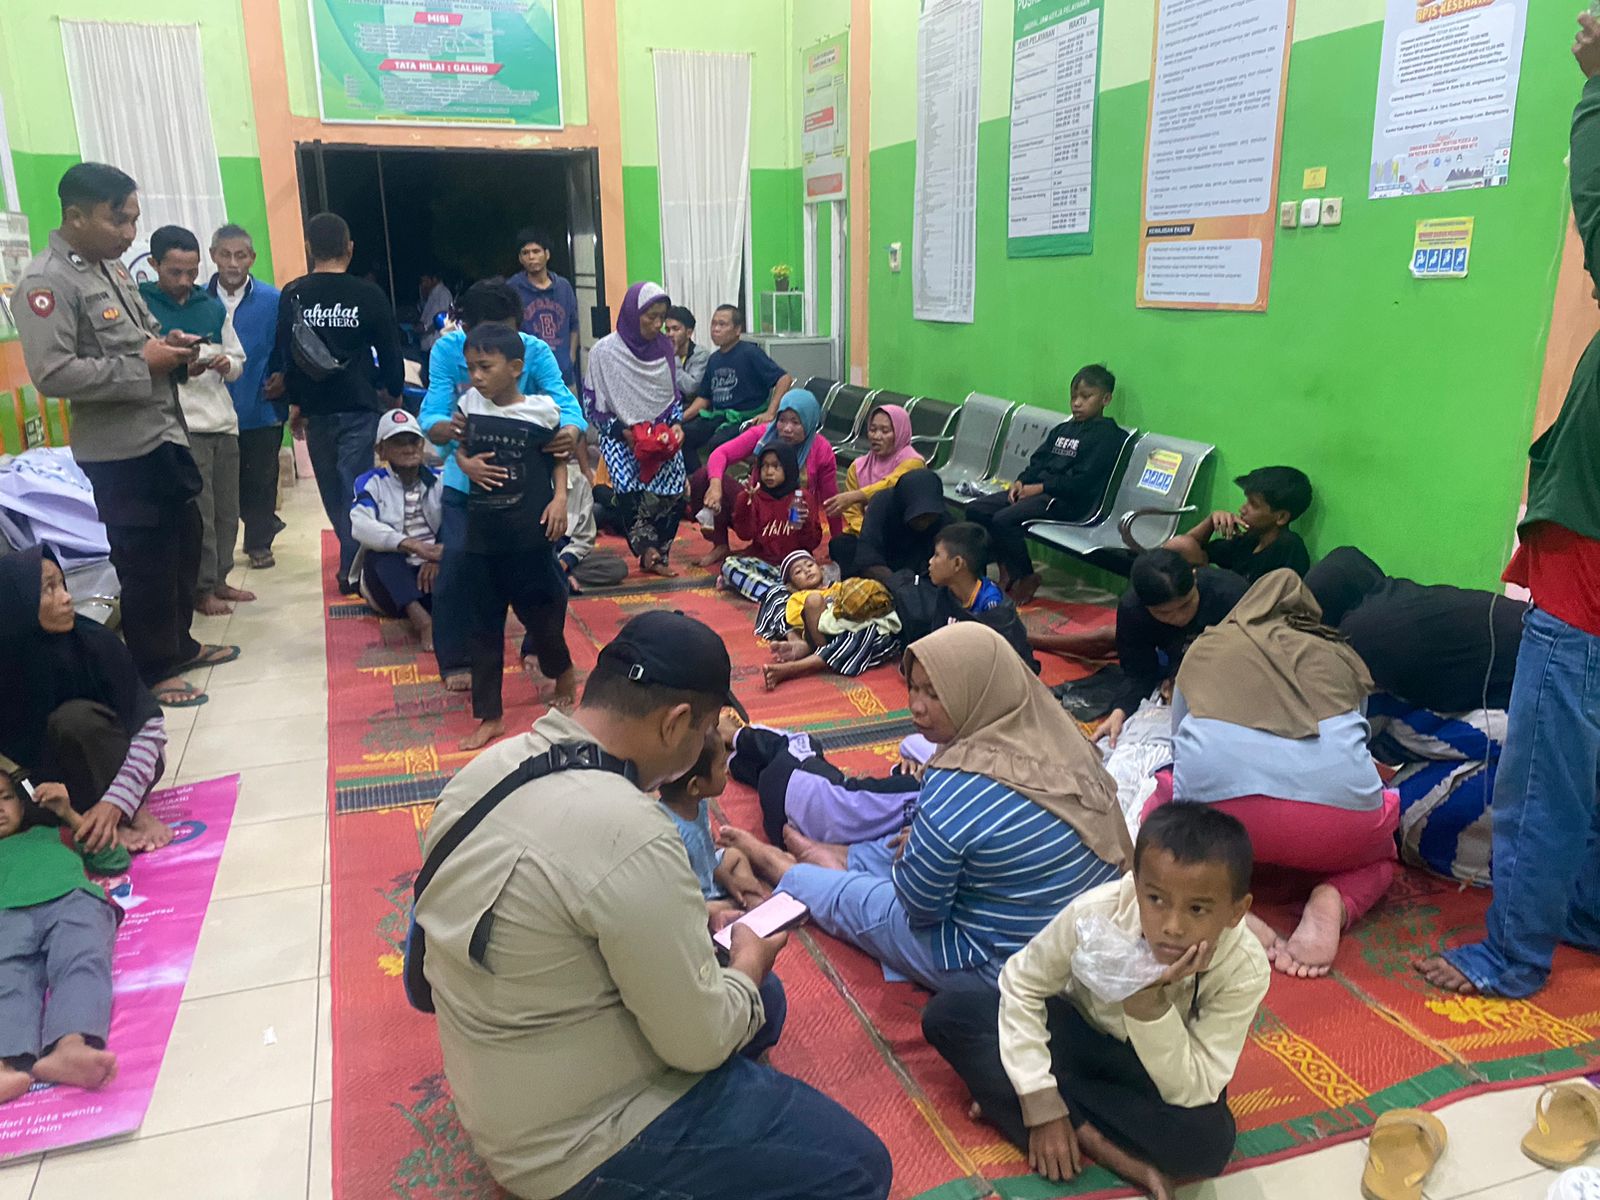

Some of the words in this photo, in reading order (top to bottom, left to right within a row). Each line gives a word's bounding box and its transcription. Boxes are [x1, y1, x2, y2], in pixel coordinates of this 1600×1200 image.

[427, 14, 449, 24] MISI
[394, 61, 417, 70] TATA
[419, 63, 445, 72] NILAI
[303, 302, 359, 319] ahabat
[328, 318, 360, 328] HERO
[33, 1113, 59, 1126] juta
[62, 1105, 103, 1120] wanita
[0, 1129, 23, 1140] her
[25, 1123, 62, 1136] rahim
